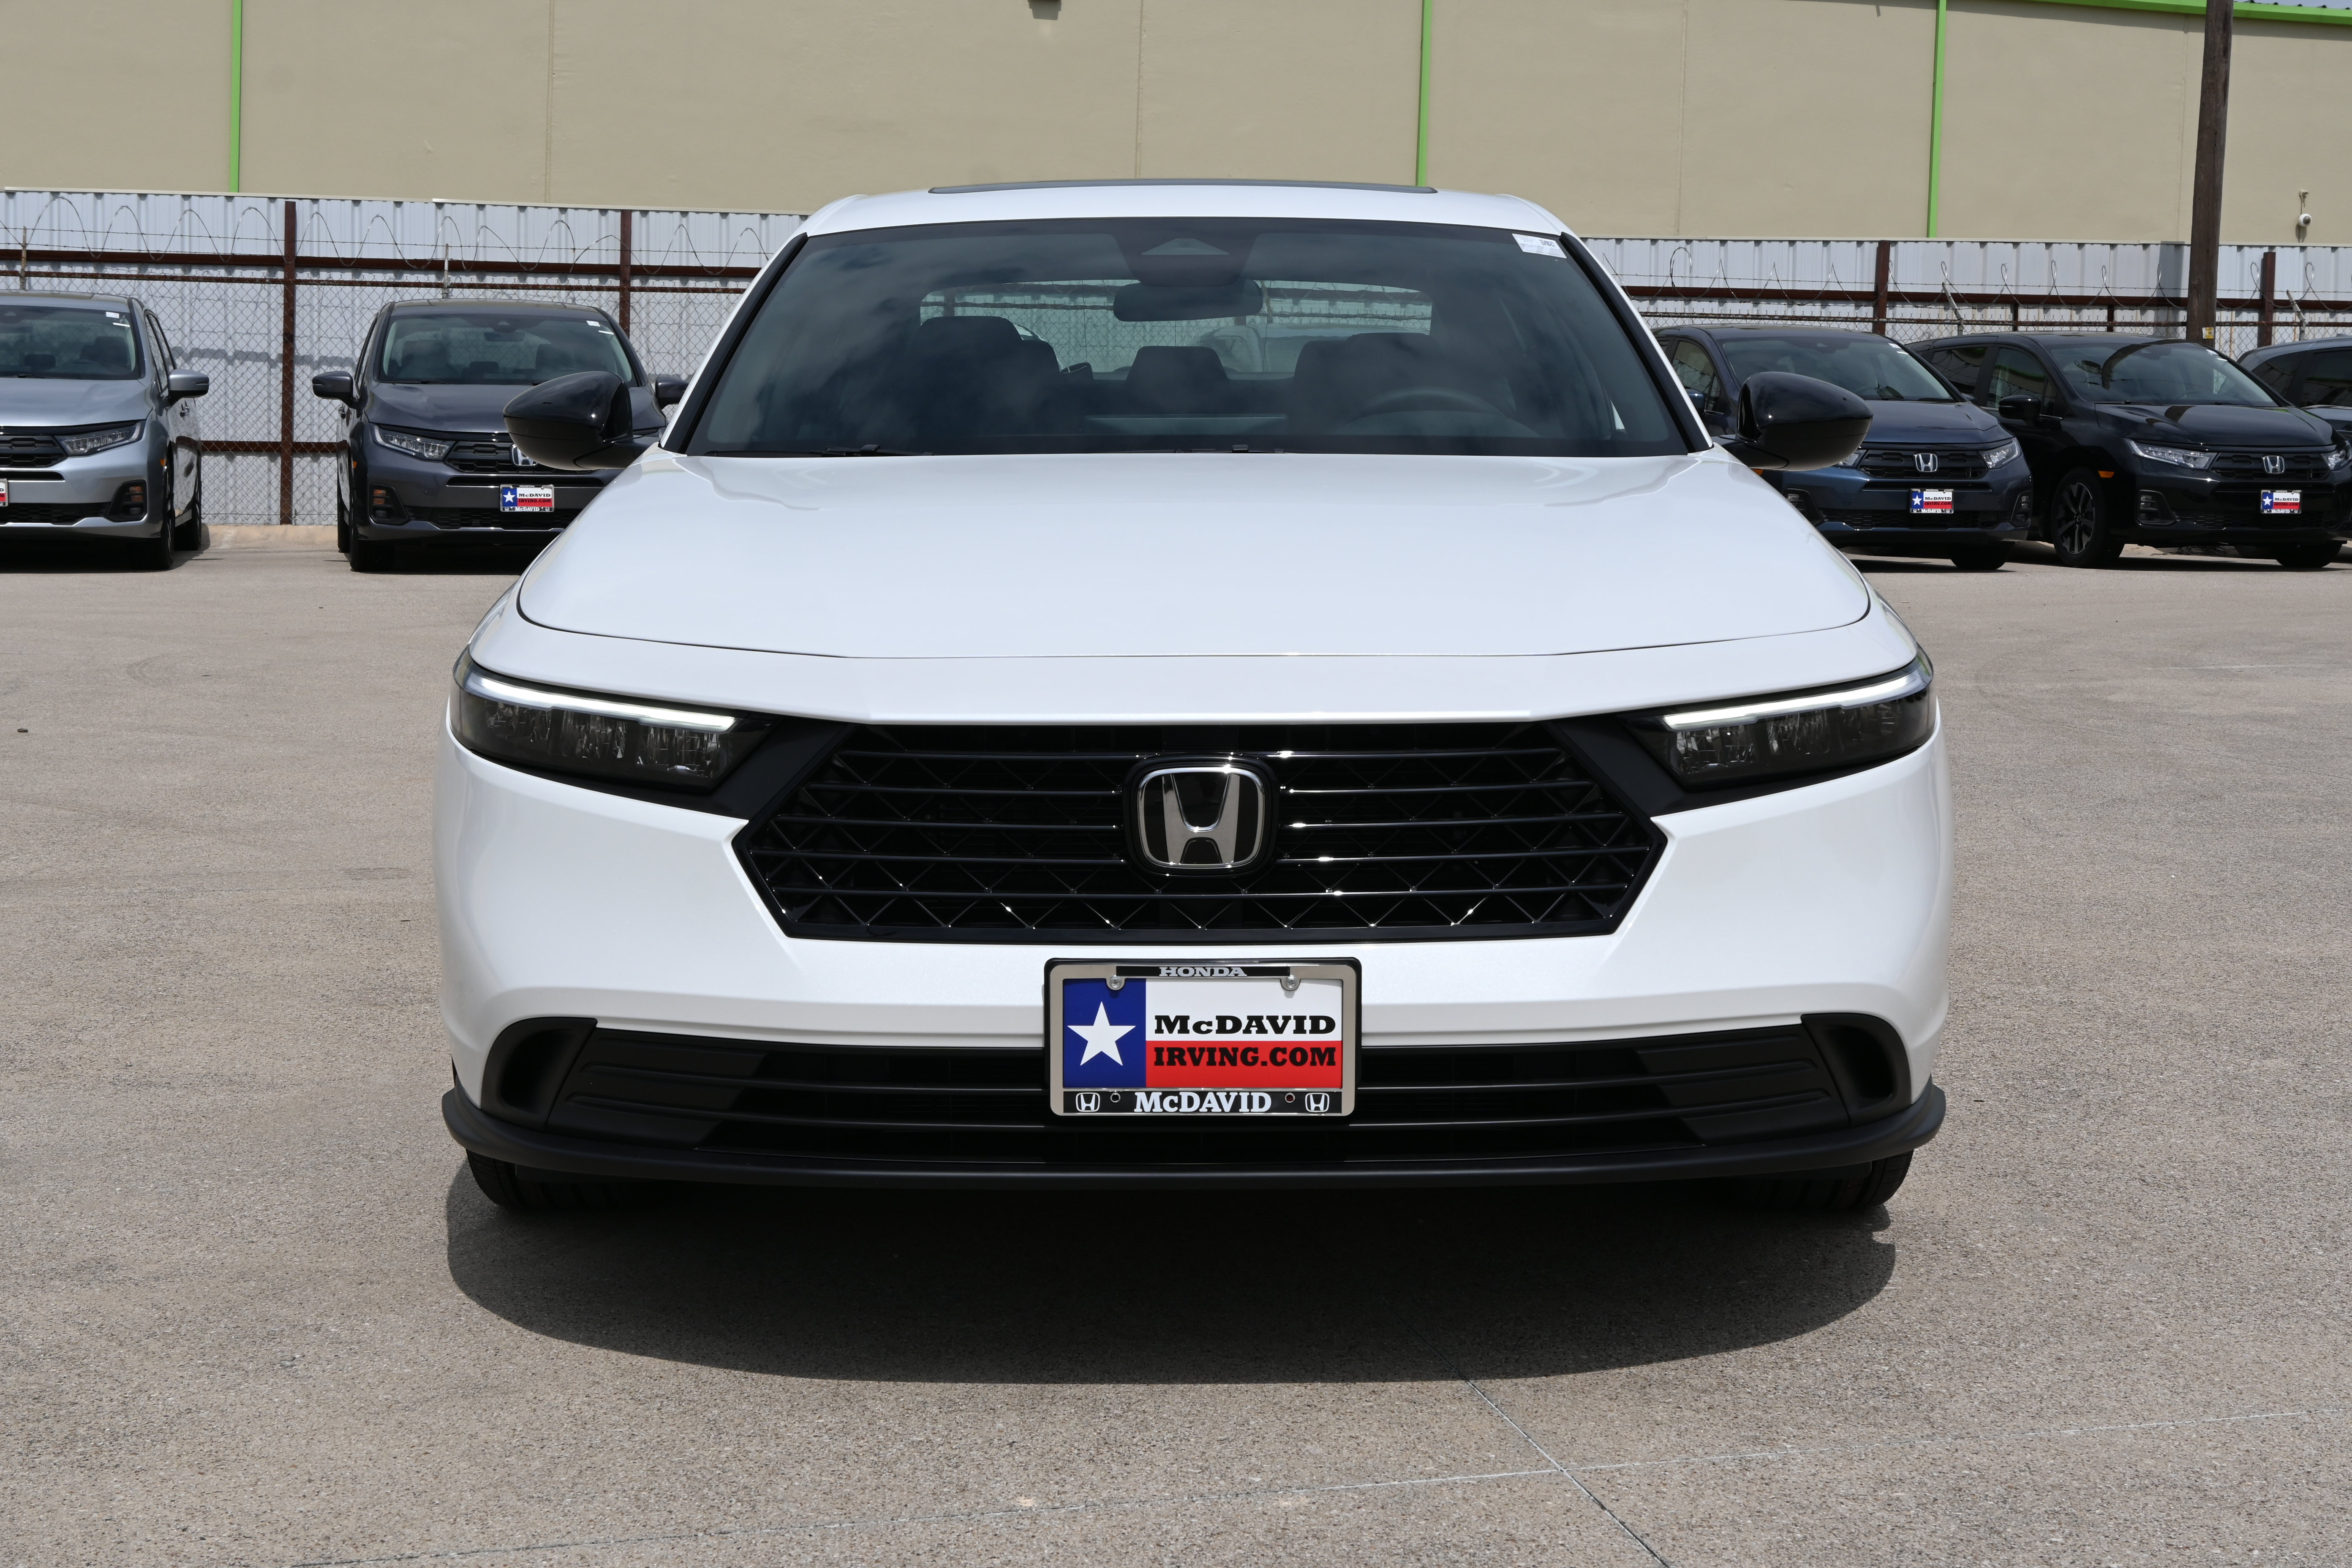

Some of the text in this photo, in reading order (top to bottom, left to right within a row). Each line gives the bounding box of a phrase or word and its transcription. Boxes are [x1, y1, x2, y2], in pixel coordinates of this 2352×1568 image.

[1159, 967, 1247, 977] HONDA
[1154, 1015, 1336, 1034] McDAVID
[1154, 1047, 1336, 1067] IRVING.COM
[1134, 1092, 1271, 1113] McDAVID
